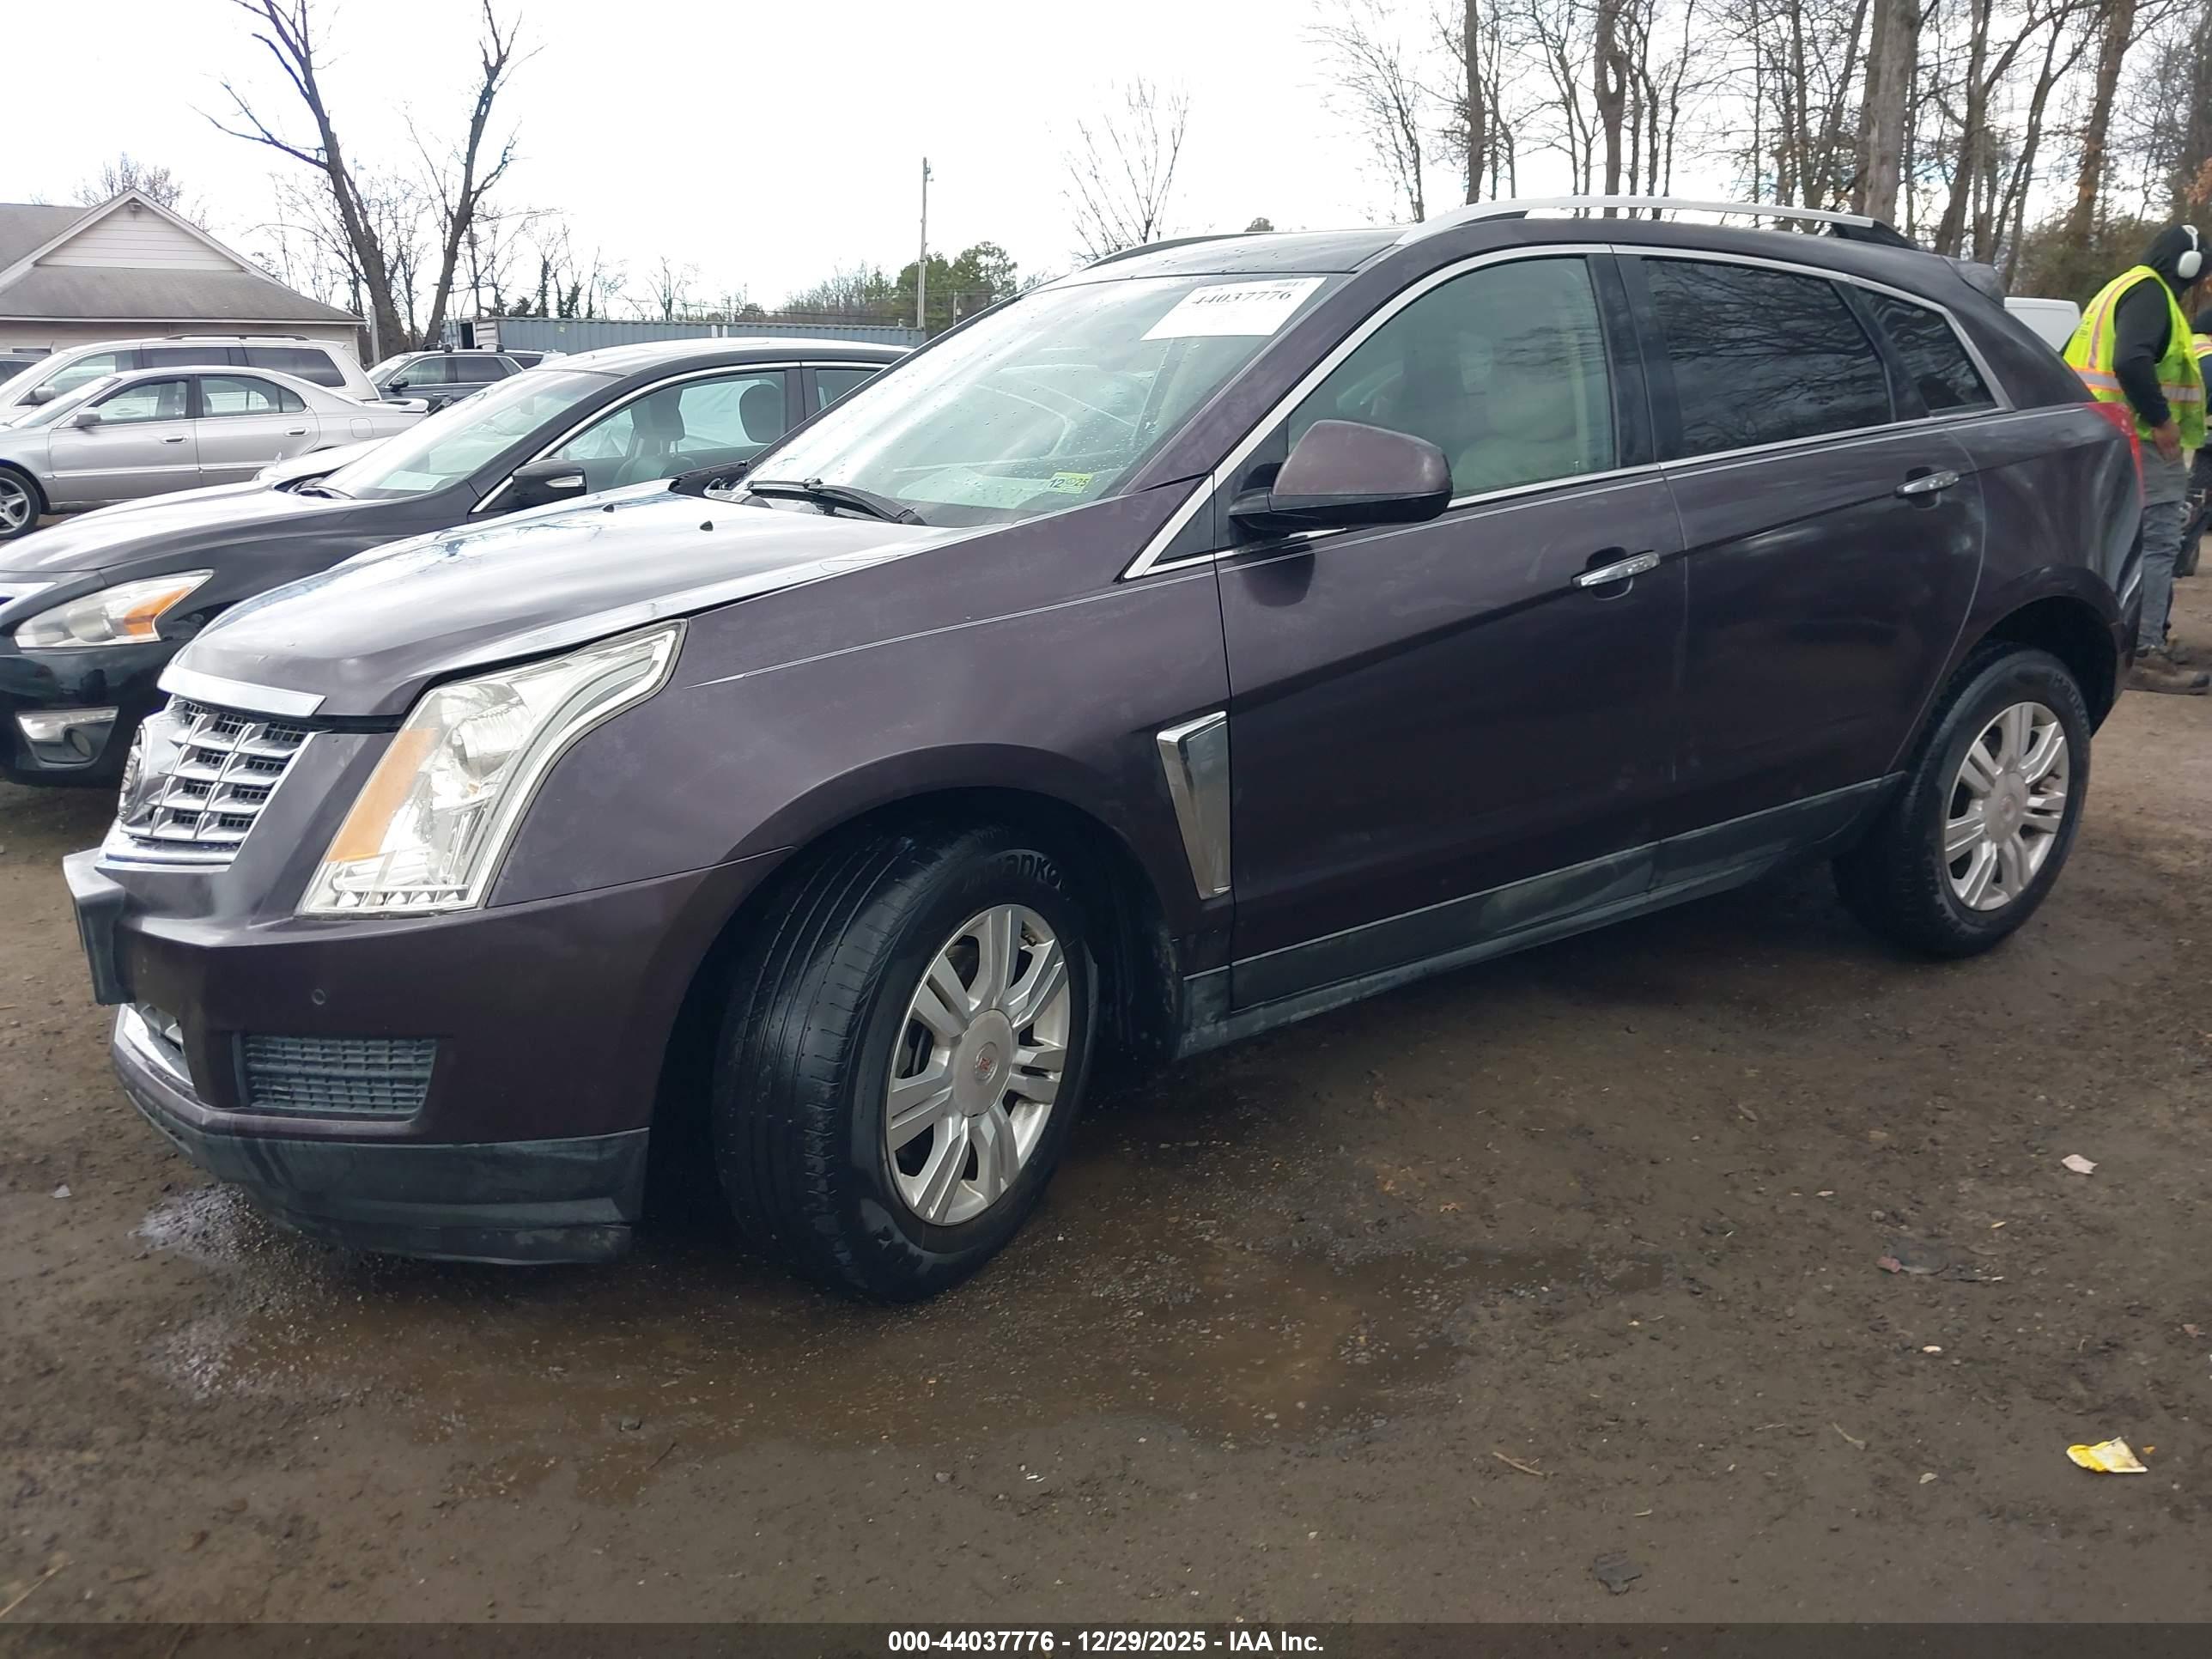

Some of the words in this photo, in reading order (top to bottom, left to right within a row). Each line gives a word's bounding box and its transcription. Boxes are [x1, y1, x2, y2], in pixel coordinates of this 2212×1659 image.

[1192, 290, 1292, 305] 44037776
[1049, 477, 1066, 489] 12
[1073, 477, 1089, 487] 25
